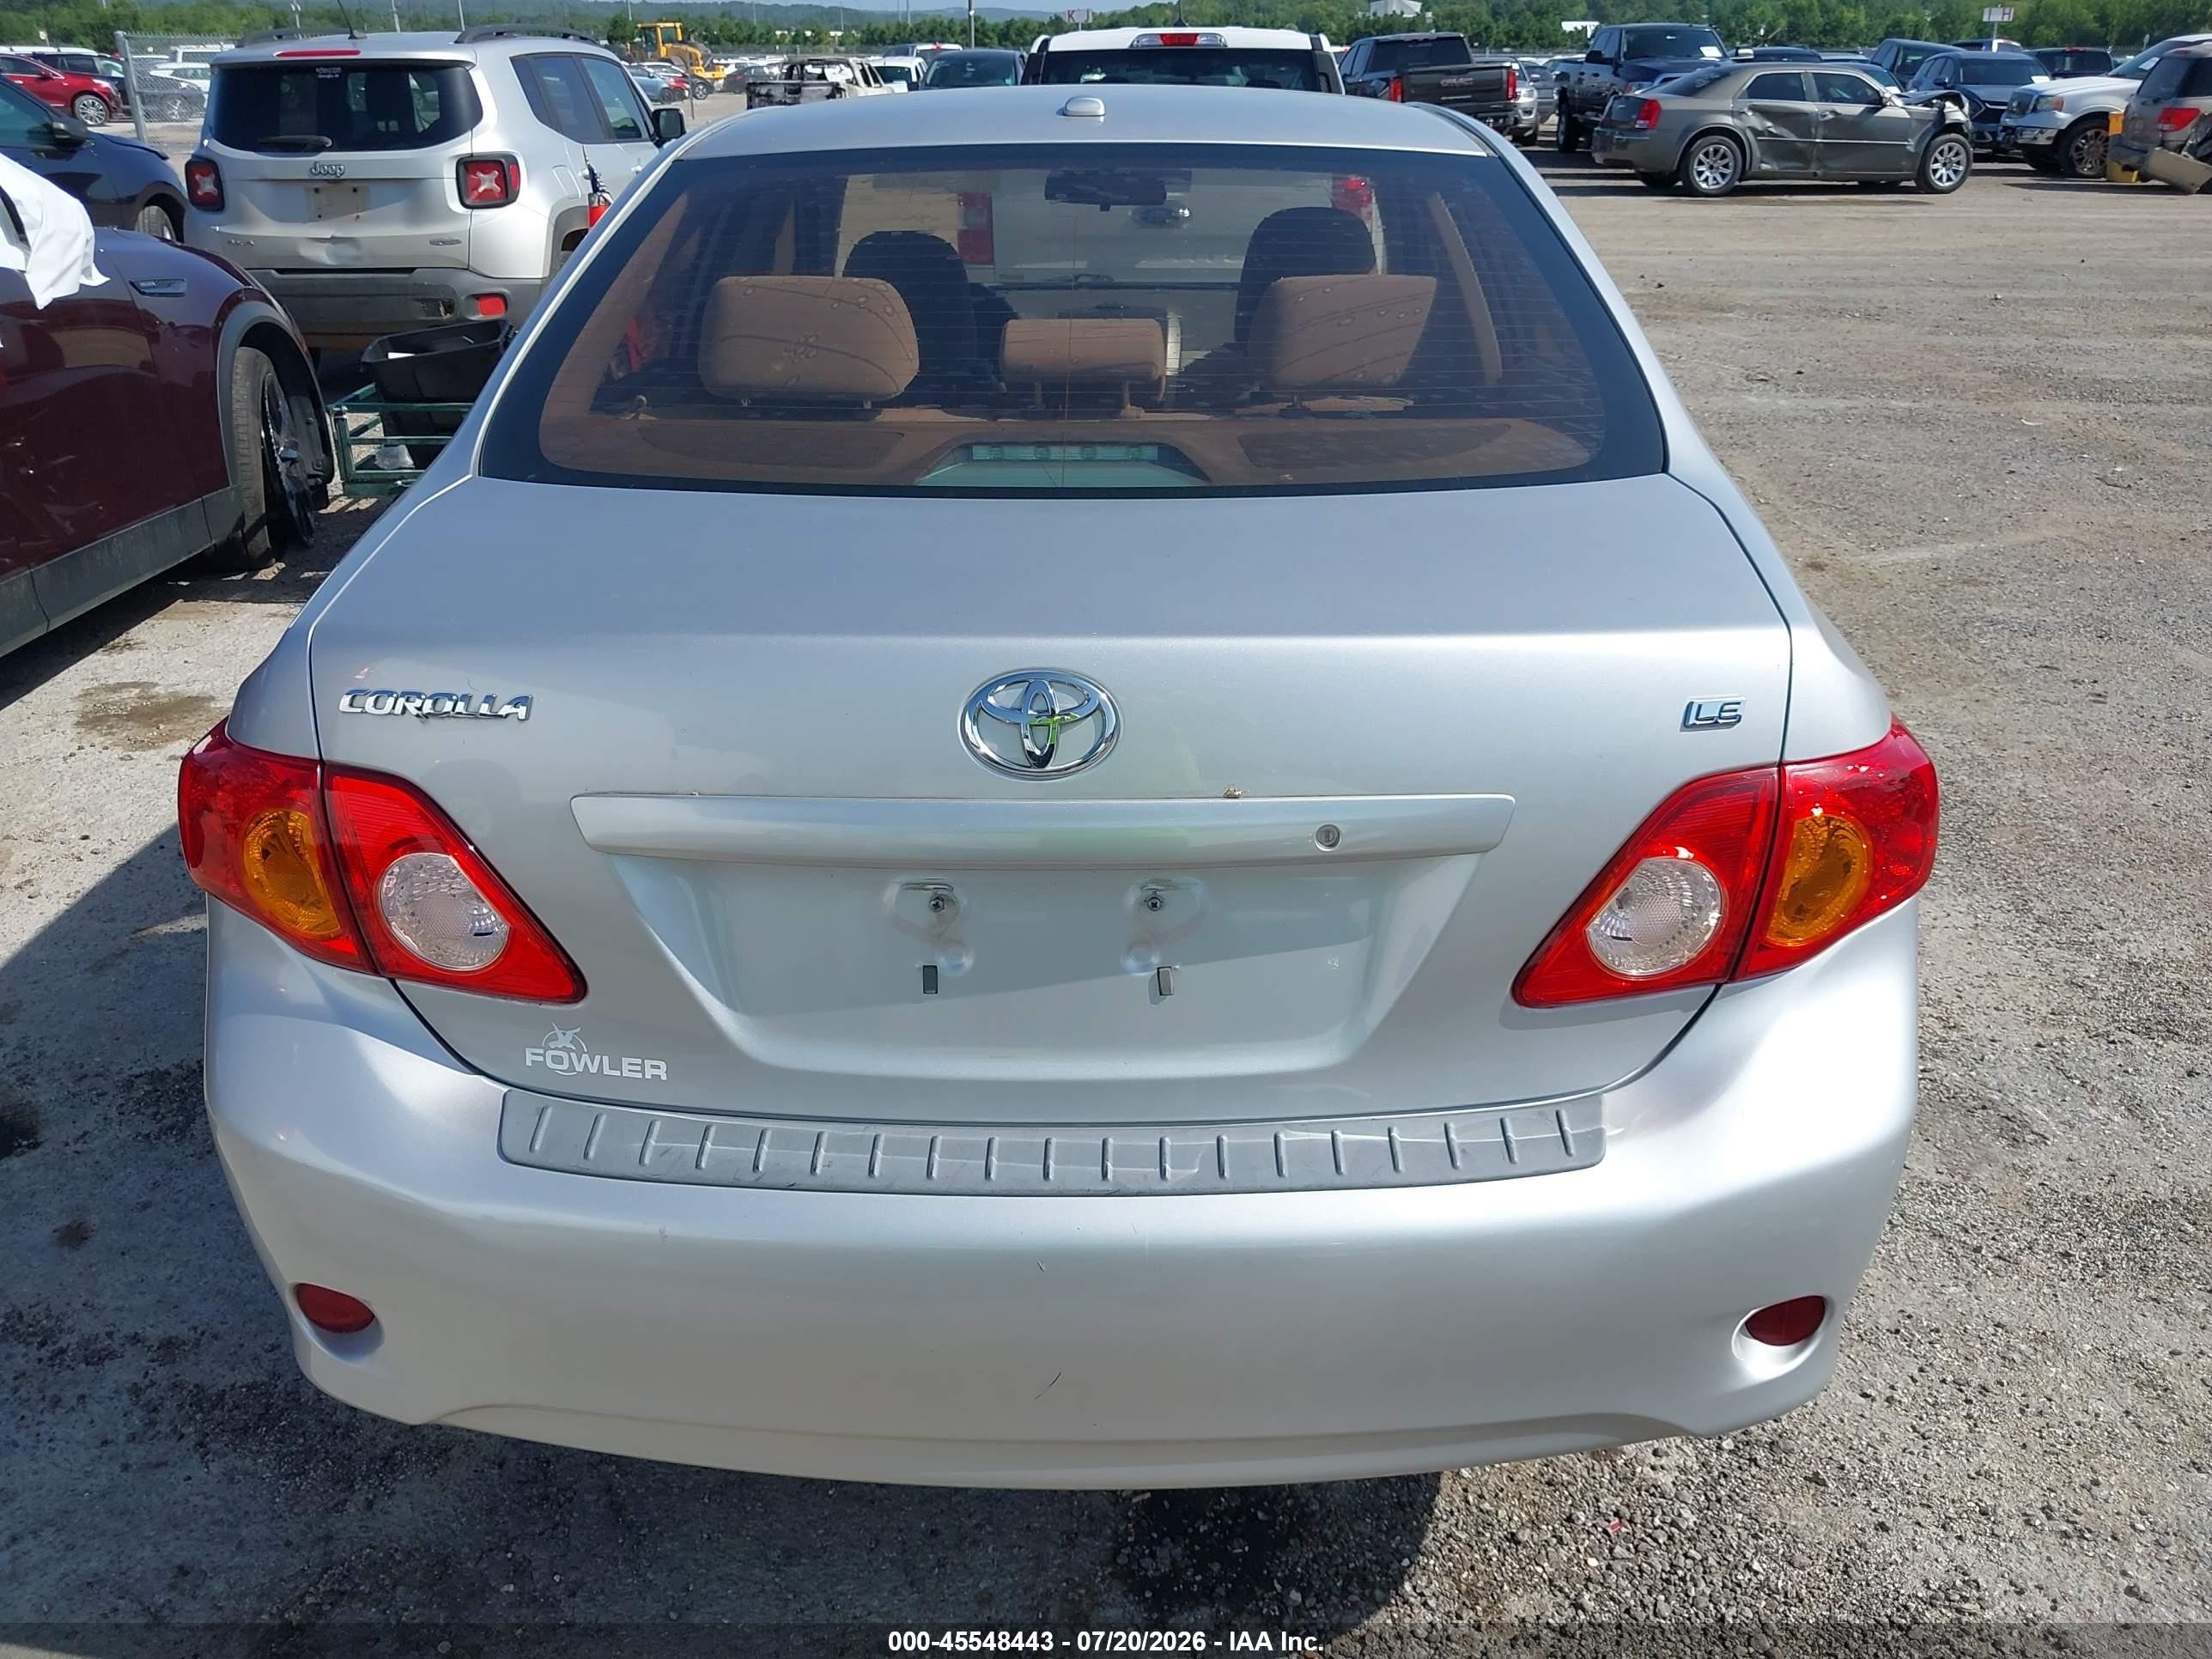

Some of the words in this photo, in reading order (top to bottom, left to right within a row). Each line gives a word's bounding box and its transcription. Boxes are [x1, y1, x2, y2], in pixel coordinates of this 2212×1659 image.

[309, 161, 345, 178] Jeep
[338, 690, 533, 720] COROLLA
[1683, 700, 1742, 729] LE
[525, 1047, 667, 1080] FOWLER
